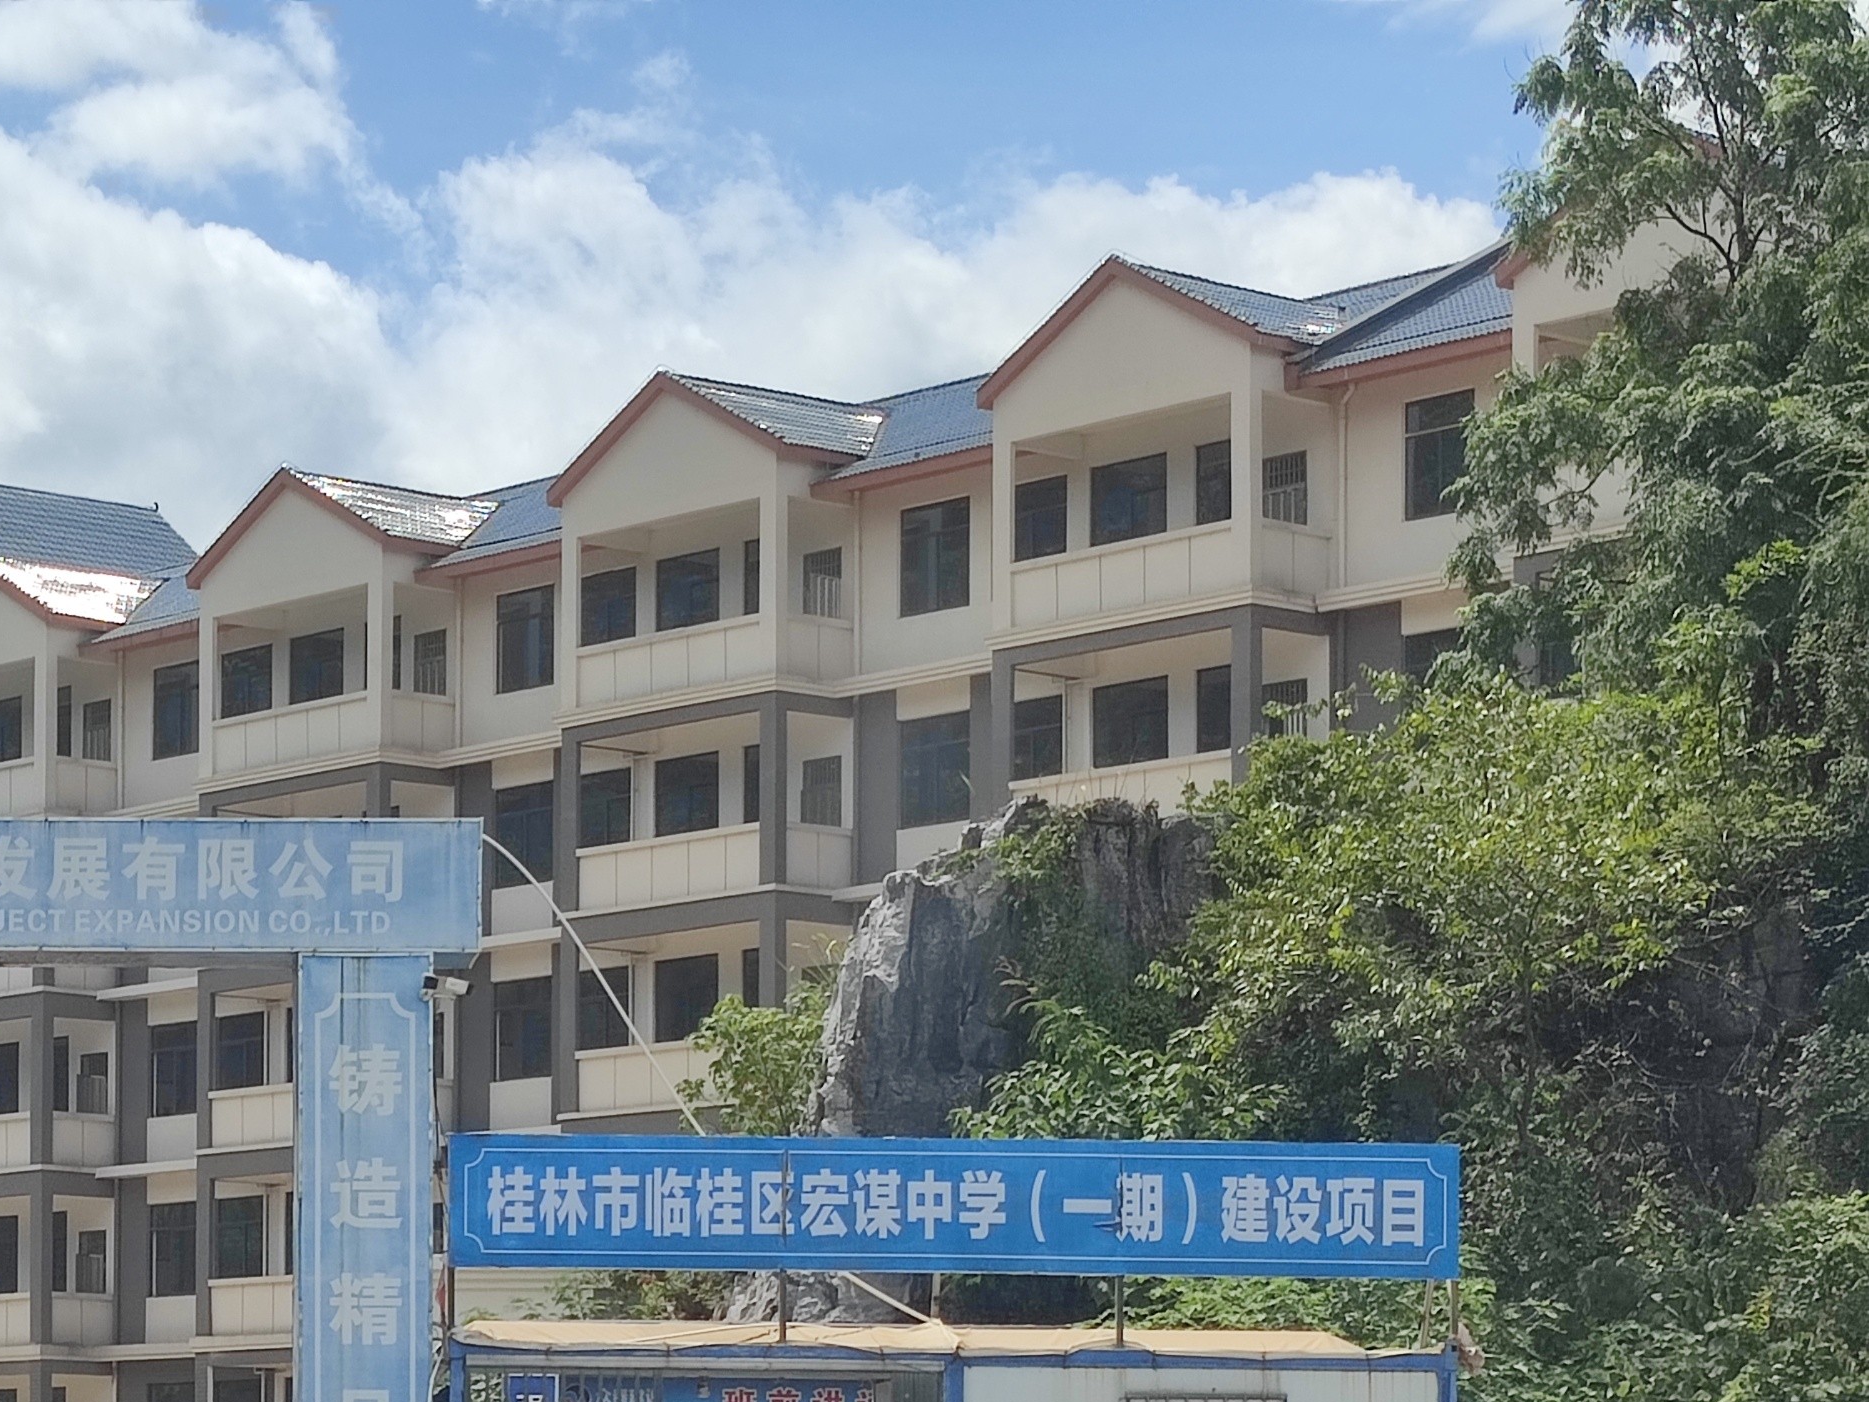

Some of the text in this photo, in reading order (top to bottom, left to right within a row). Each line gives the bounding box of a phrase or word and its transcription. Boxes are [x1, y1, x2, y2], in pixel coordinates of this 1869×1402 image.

[74, 909, 259, 935] EXPANSION
[487, 1165, 1426, 1248] 桂林市临桂区宏谋中学（一期）建设项目
